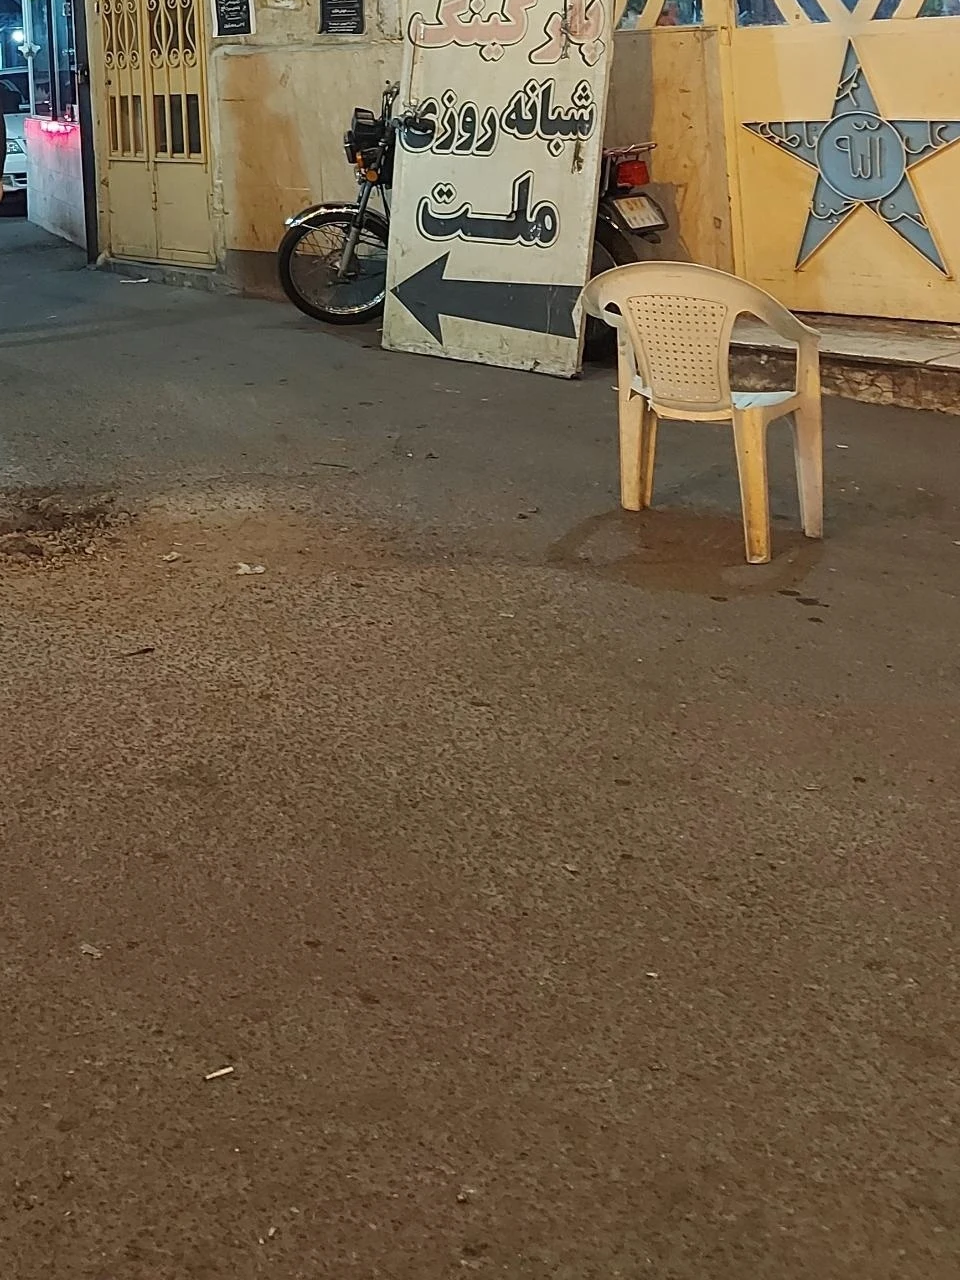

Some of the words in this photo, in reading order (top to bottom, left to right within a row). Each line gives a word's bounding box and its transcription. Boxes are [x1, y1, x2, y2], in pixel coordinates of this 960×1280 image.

[399, 89, 499, 156] روزی
[499, 77, 597, 157] شبانه
[416, 170, 562, 249] ملت
